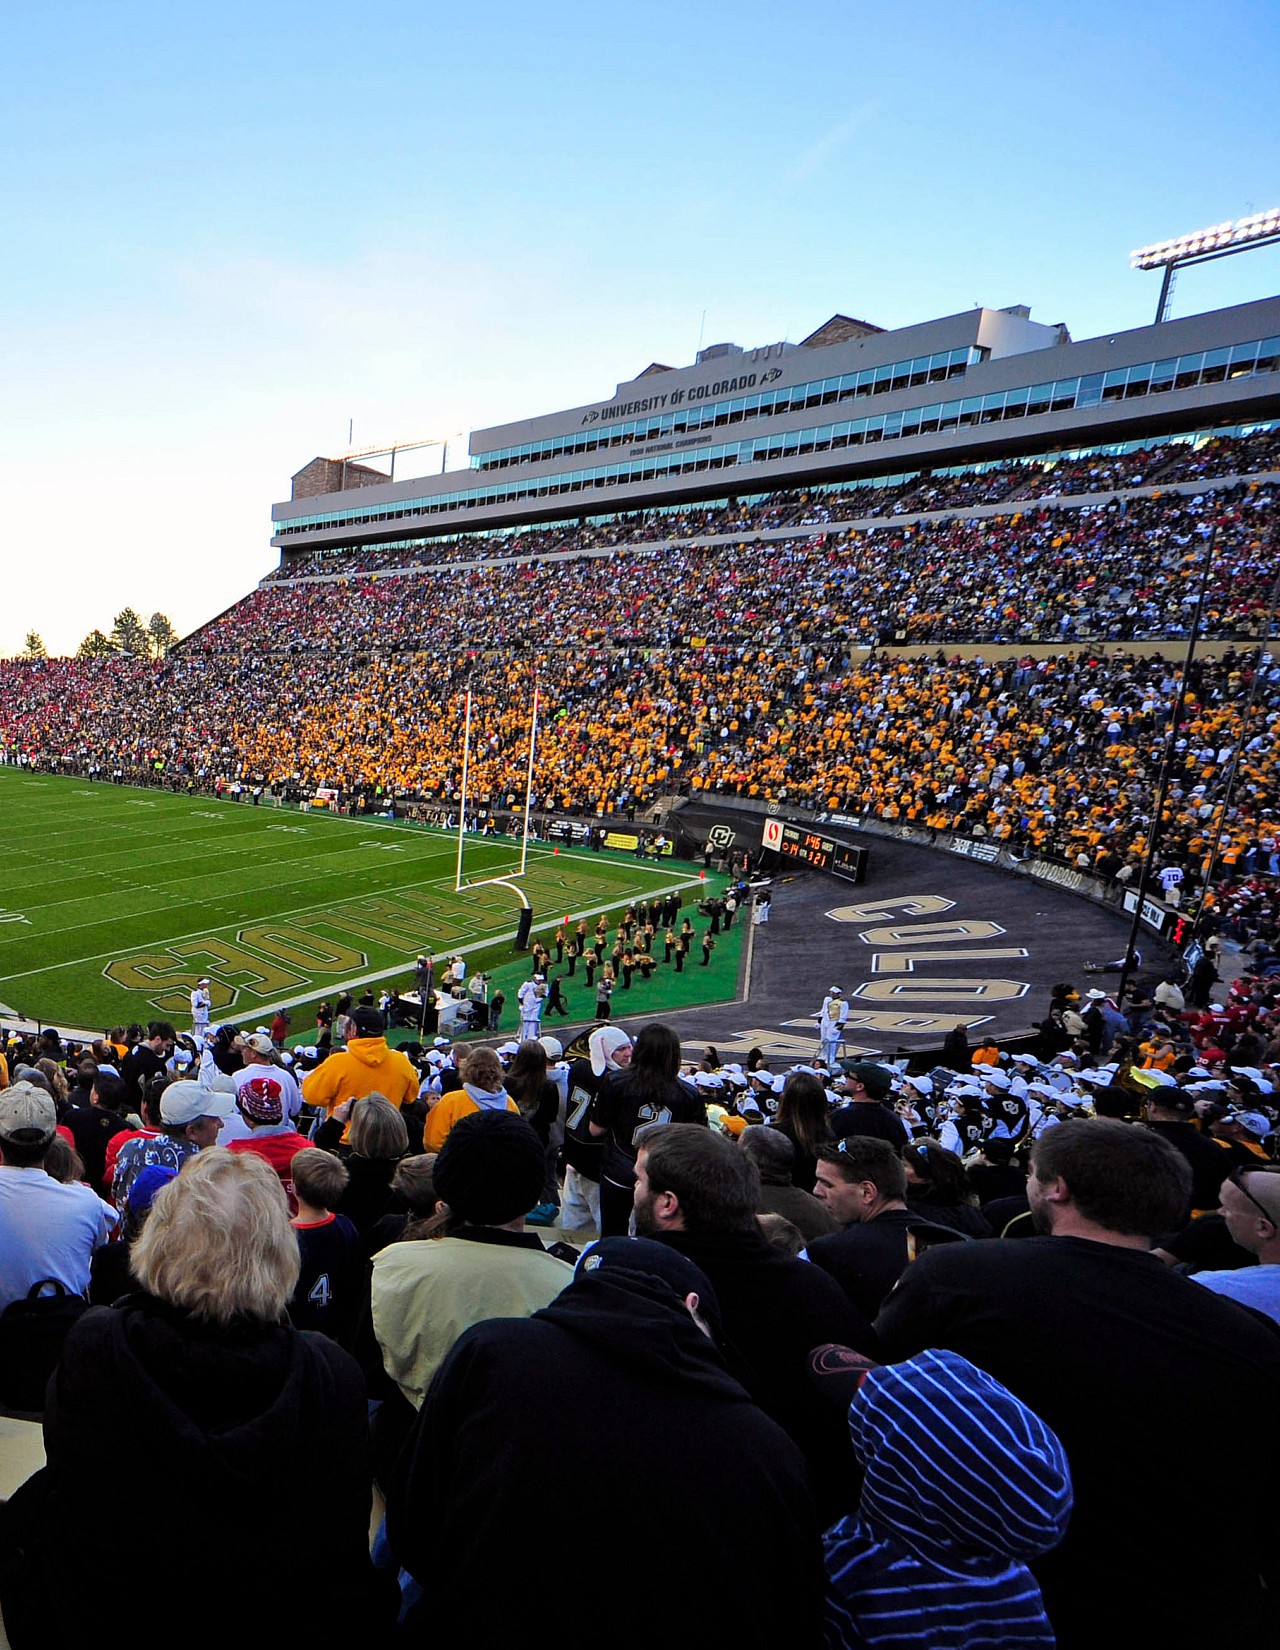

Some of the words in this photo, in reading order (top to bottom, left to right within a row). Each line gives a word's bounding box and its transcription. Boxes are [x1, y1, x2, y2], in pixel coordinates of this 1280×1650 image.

[601, 394, 668, 421] UNIVERSITY
[670, 390, 686, 405] OF
[688, 373, 757, 401] COLORADO
[710, 824, 736, 848] CU
[789, 843, 799, 856] 14
[813, 852, 827, 867] 21
[1030, 860, 1082, 889] COLORADO
[1167, 873, 1179, 882] 10
[566, 1085, 591, 1131] 7
[307, 1272, 333, 1310] 4
